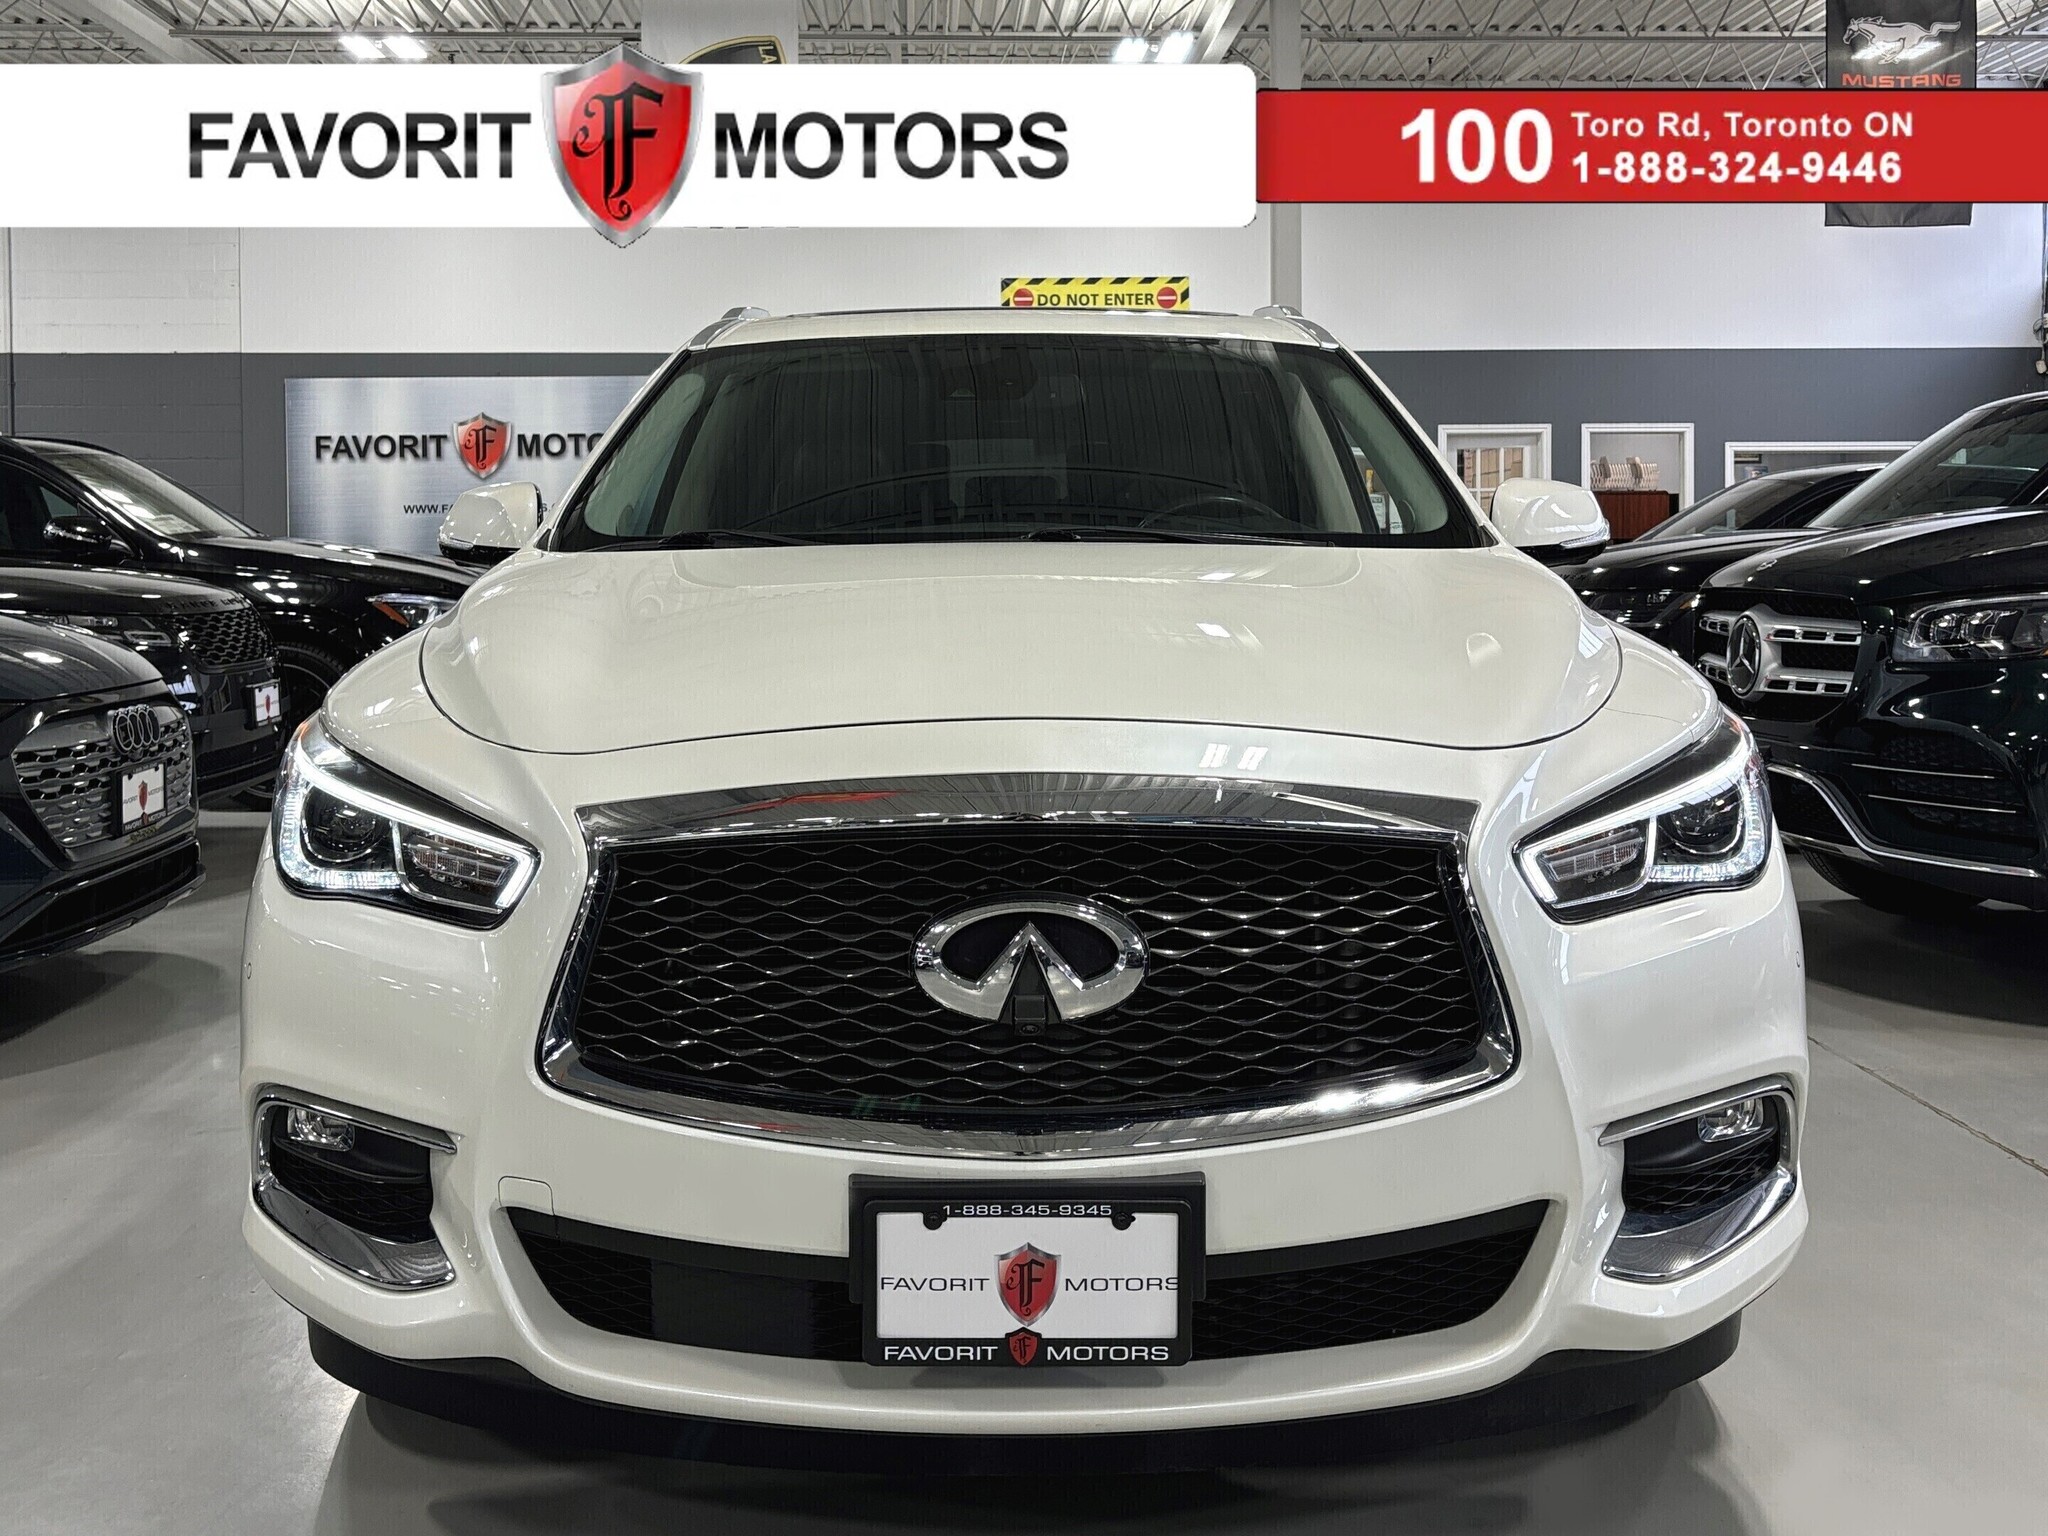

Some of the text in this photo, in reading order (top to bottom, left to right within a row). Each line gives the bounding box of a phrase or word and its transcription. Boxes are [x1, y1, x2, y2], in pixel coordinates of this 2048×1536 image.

[1842, 73, 1961, 88] MUSTANG
[1037, 293, 1154, 306] DO NOT ENTER
[315, 434, 447, 460] FAVORIT
[942, 1204, 1112, 1216] 1-888-345-9345
[881, 1277, 1179, 1292] FAVORIT MOTORS
[884, 1346, 1169, 1361] FAVORIT MOTORS
